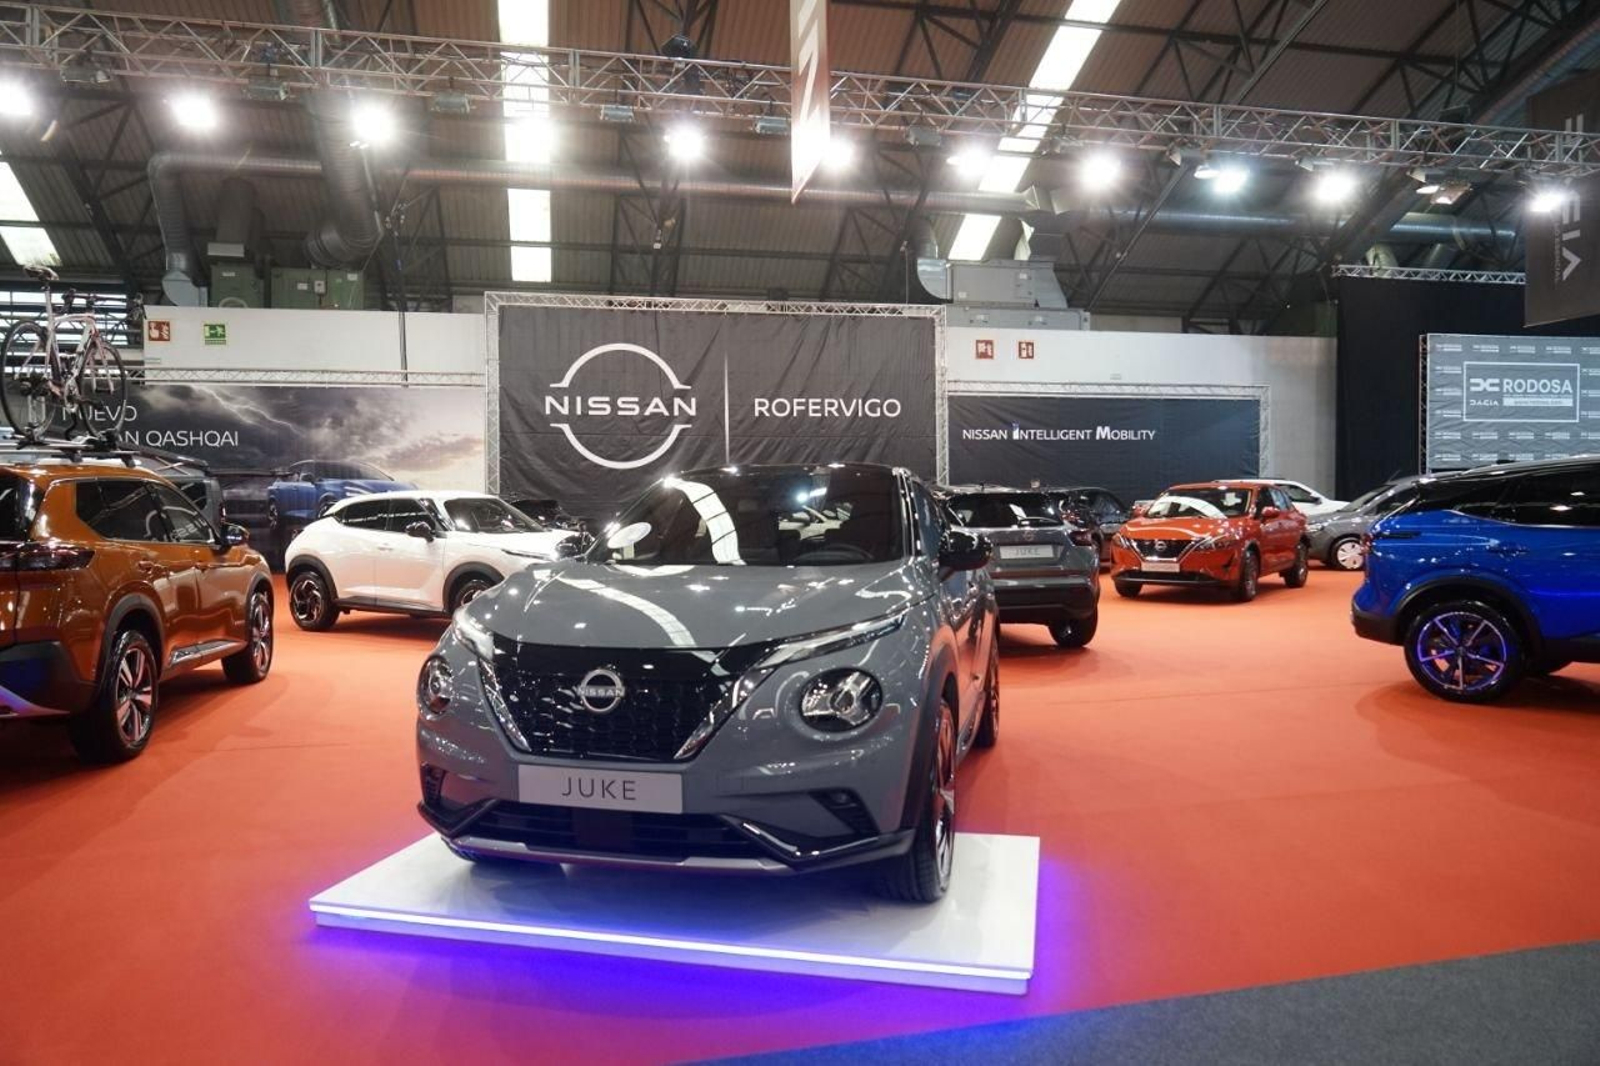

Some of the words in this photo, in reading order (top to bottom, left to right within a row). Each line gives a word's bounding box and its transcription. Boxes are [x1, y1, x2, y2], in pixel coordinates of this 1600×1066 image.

[1503, 378, 1573, 394] RODOSA
[544, 394, 697, 417] NISSAN
[753, 397, 902, 419] ROFERVIGO
[145, 430, 238, 447] QASHQAI
[962, 428, 1008, 441] NISSAN
[1095, 425, 1156, 441] MOBILITY
[561, 776, 636, 801] JUKE
